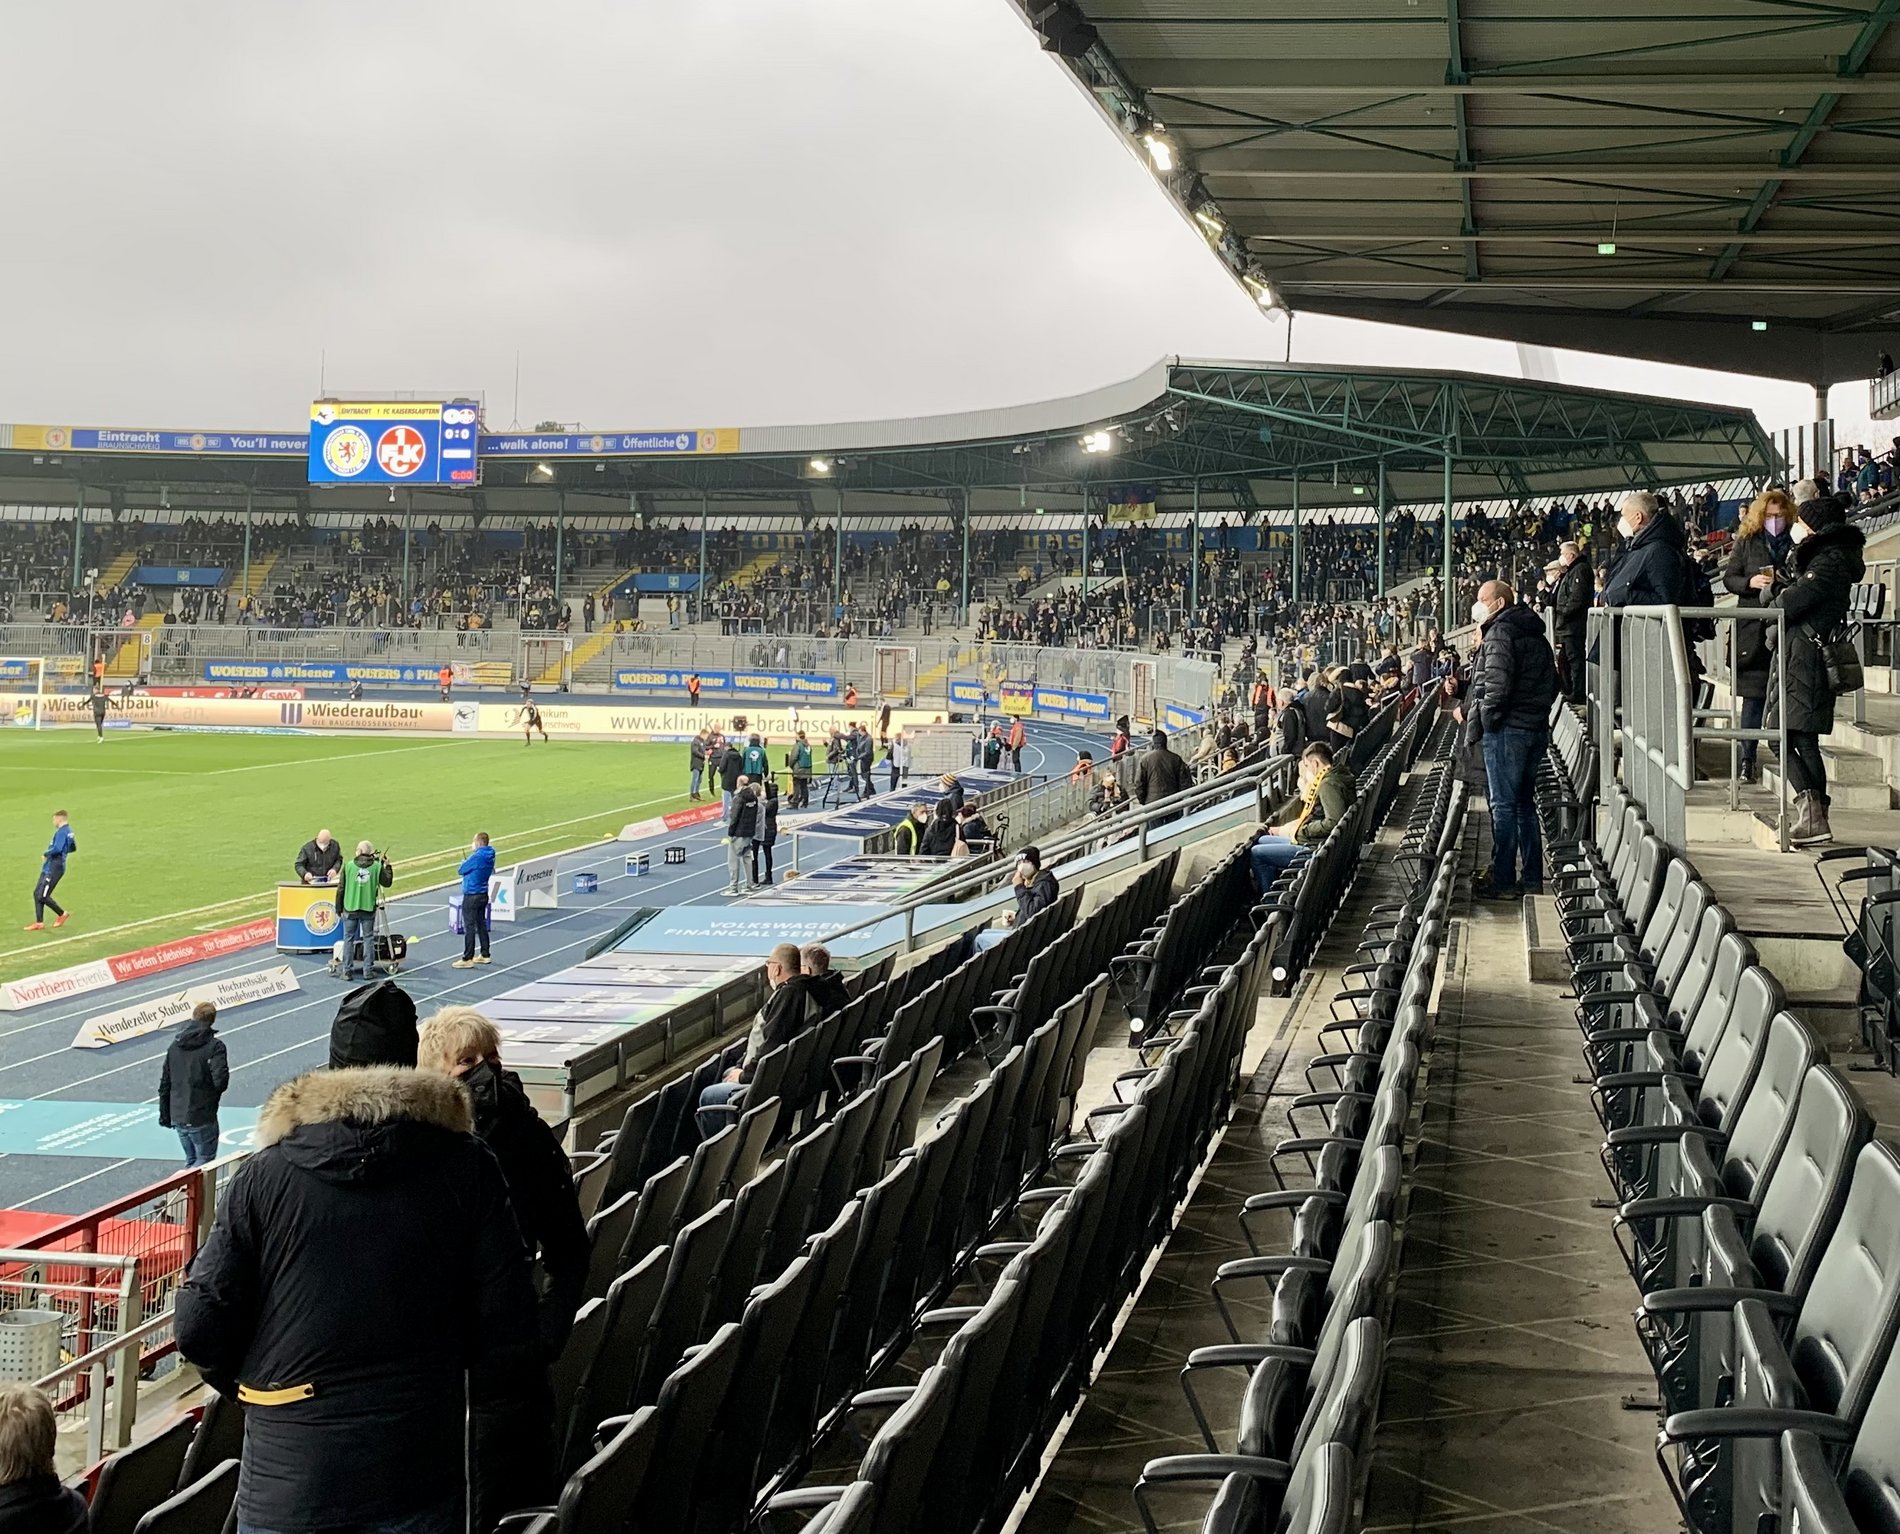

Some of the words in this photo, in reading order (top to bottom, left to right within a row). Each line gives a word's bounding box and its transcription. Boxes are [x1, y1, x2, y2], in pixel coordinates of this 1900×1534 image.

[392, 407, 439, 415] KAISERSLAUTERN
[98, 430, 160, 442] Eintracht
[623, 435, 675, 449] Öffentliche
[97, 441, 160, 449] BRAUNSCHWEIG
[230, 437, 267, 449] You'll
[270, 438, 308, 450] never
[531, 437, 568, 450] alone!
[210, 665, 268, 678] WOLTERS
[284, 667, 335, 679] Pilsener
[346, 668, 400, 680] WOLTERS
[416, 669, 439, 680] Pils
[619, 673, 667, 685] WOLTERS
[735, 675, 779, 689] WOLTERS
[792, 678, 832, 692] Pilsener
[329, 719, 418, 728] BAUGENOSSENSCHAFT
[709, 921, 847, 930] VOLKSWAGEN
[664, 928, 771, 937] FINANCIAL
[116, 961, 131, 975] Wir
[131, 954, 157, 971] liefern
[12, 979, 76, 1004] Northern
[76, 967, 110, 989] Events
[217, 975, 268, 994] Hochzeitssäle
[217, 989, 261, 1006] Wendeburg
[261, 984, 276, 995] und
[276, 981, 287, 991] BS
[98, 1010, 158, 1037] Wendezeller
[159, 1001, 192, 1019] Stuben
